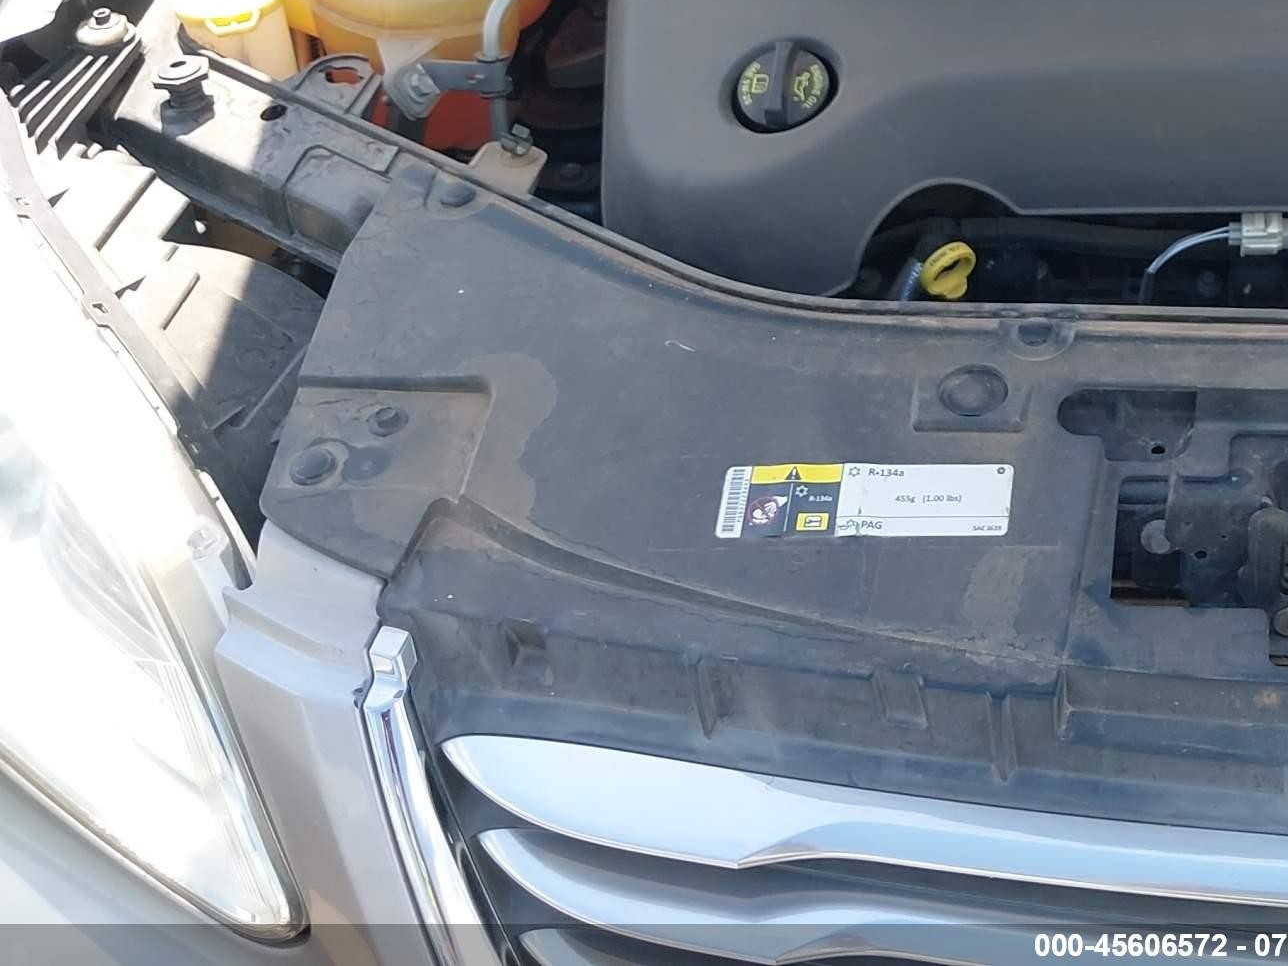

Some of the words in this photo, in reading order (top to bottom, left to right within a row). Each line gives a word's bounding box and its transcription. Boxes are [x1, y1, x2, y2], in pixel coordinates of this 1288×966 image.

[868, 467, 905, 477] R-134a
[895, 494, 916, 504] 455g
[922, 494, 945, 504] (1.00
[946, 494, 962, 504] lbs)
[860, 520, 883, 530] PAG
